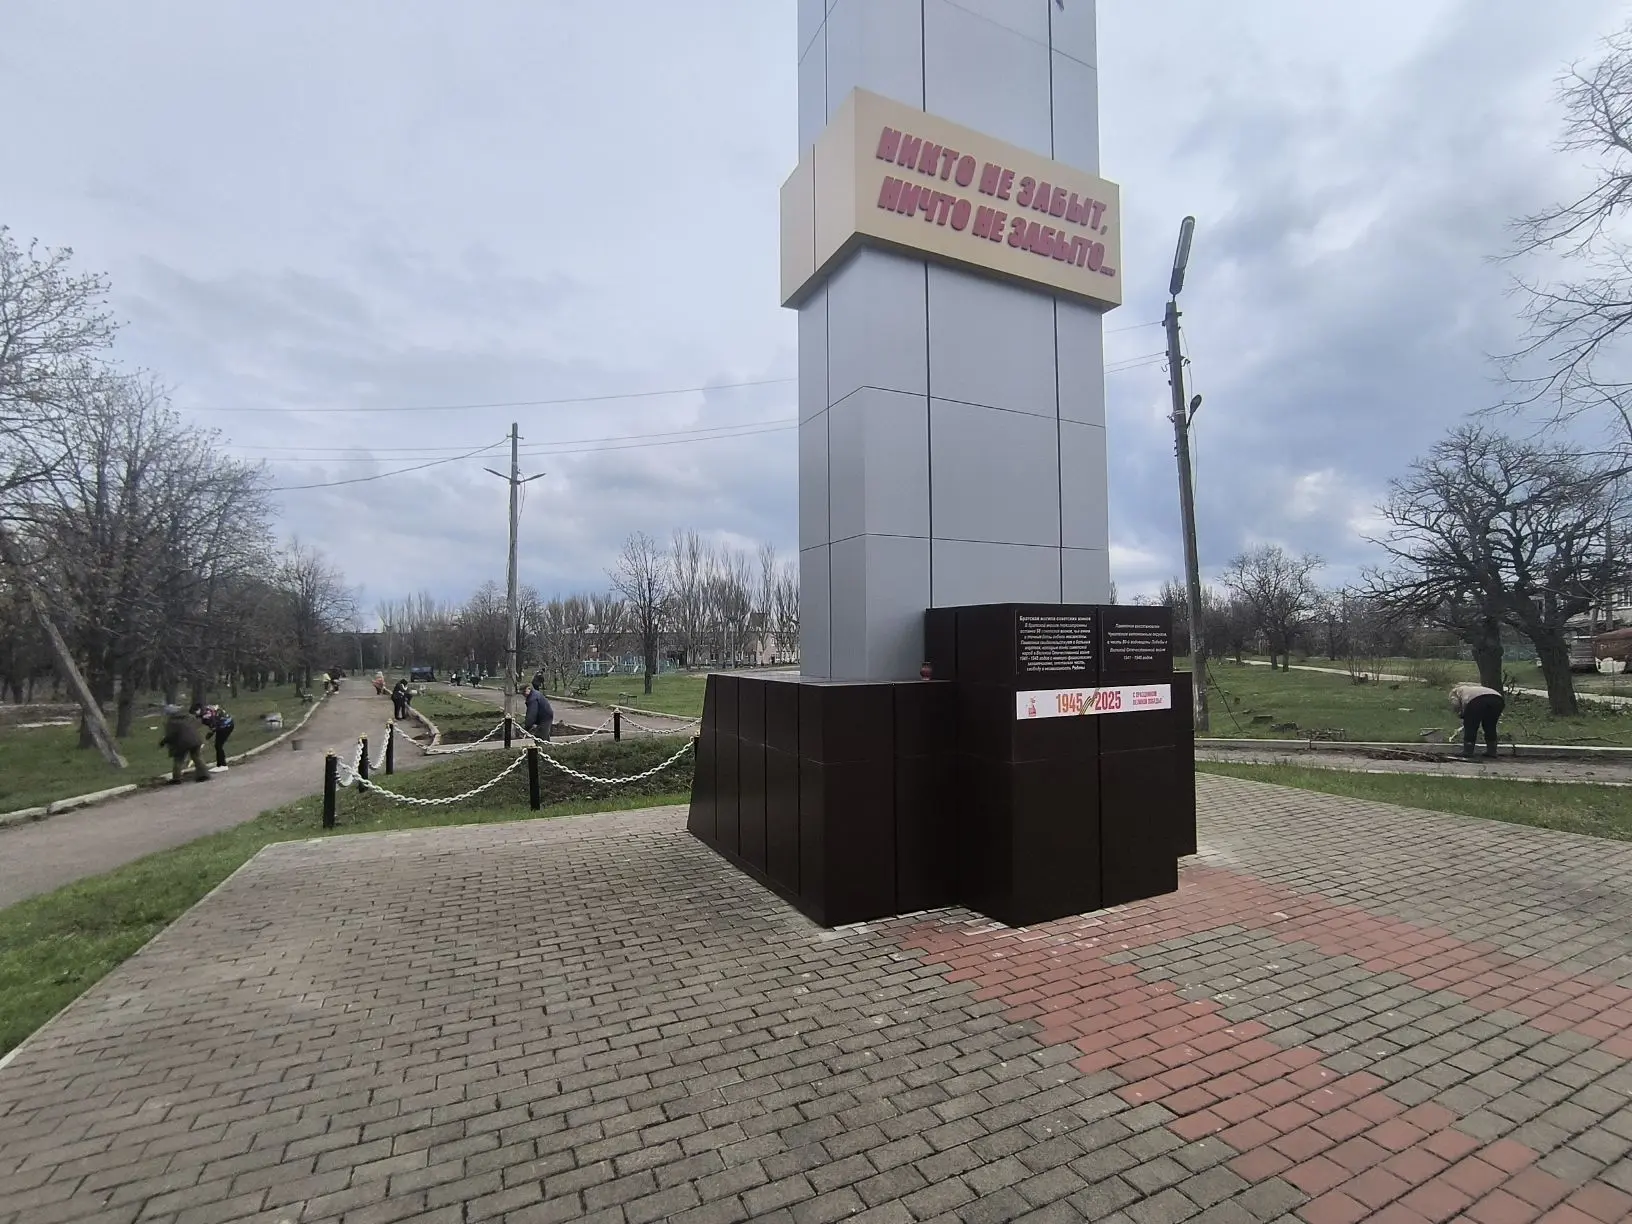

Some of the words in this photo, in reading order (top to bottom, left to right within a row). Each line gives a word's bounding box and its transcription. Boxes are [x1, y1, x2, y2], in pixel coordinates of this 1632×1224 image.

[876, 126, 977, 187] НИКТО
[978, 162, 1016, 200] НЕ
[1016, 176, 1107, 235] ЗАБЫТ,
[877, 176, 972, 231] НИЧТО
[972, 206, 1008, 243] НЕ
[1056, 692, 1083, 713] 1945
[1094, 690, 1121, 711] 2025
